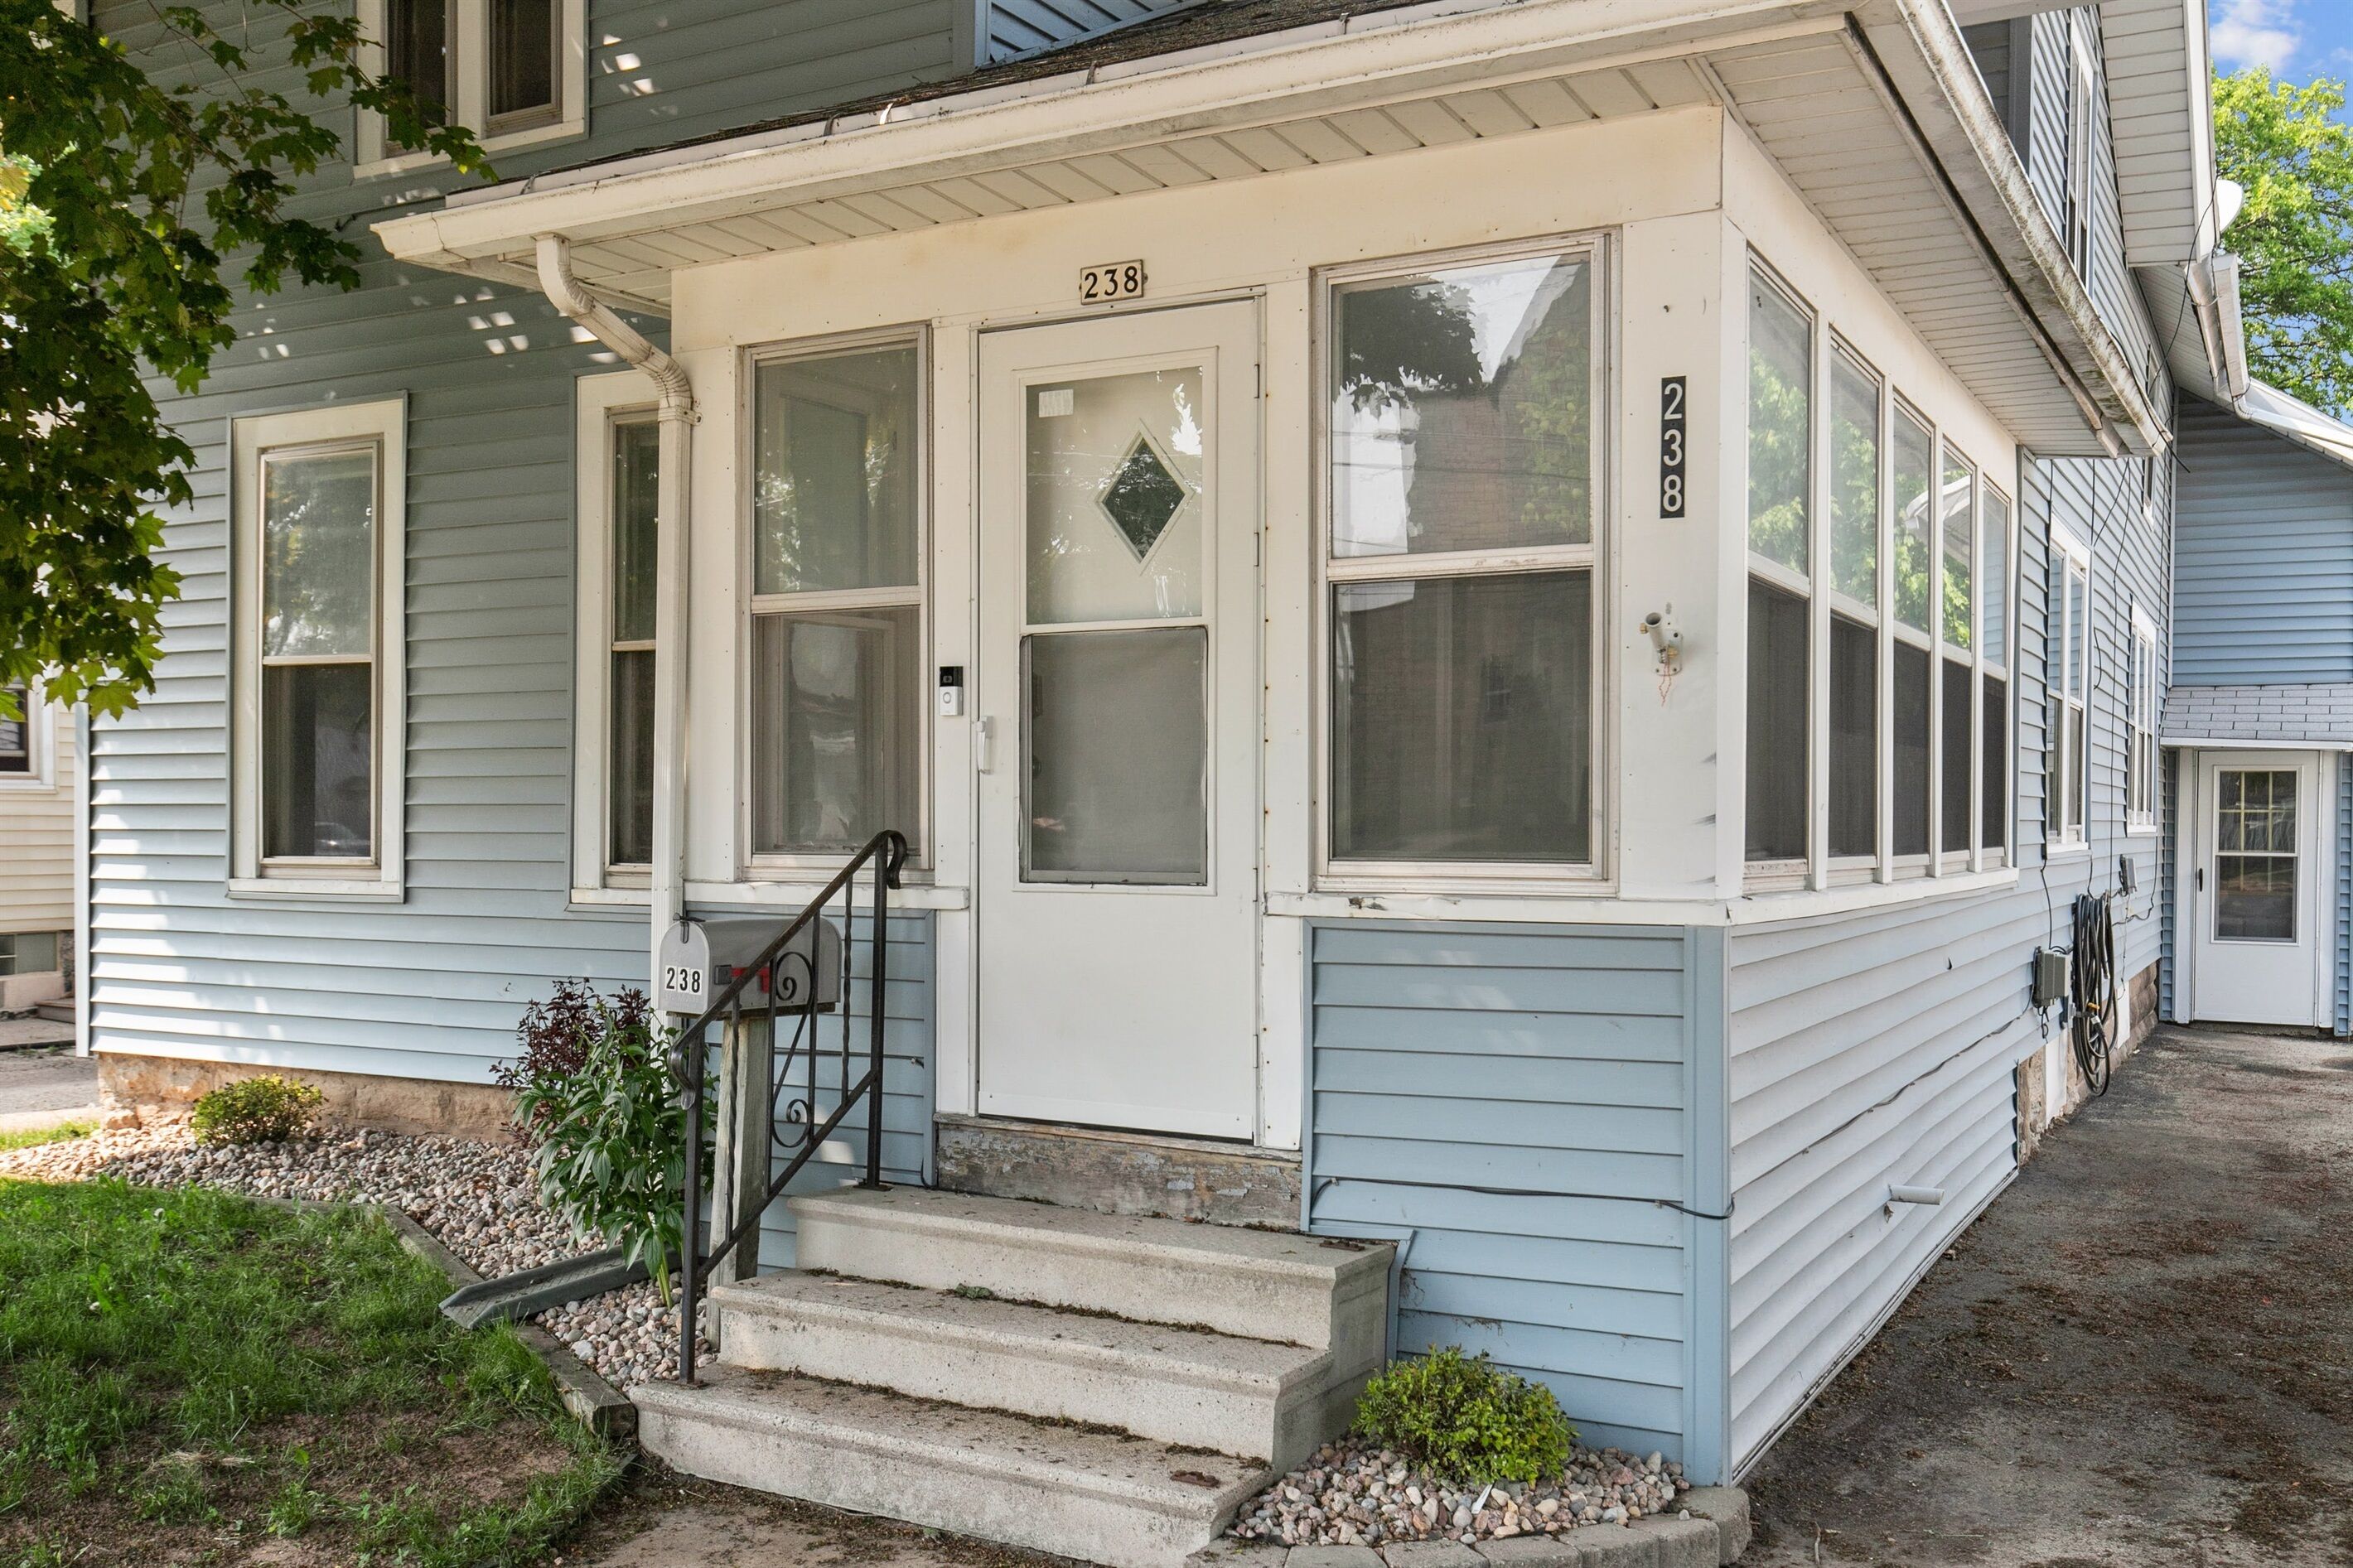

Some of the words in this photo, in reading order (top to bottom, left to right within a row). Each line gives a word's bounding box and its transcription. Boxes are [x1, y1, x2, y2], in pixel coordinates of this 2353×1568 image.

[1084, 265, 1138, 299] 238
[1663, 383, 1683, 512] 238
[666, 967, 701, 993] 238
